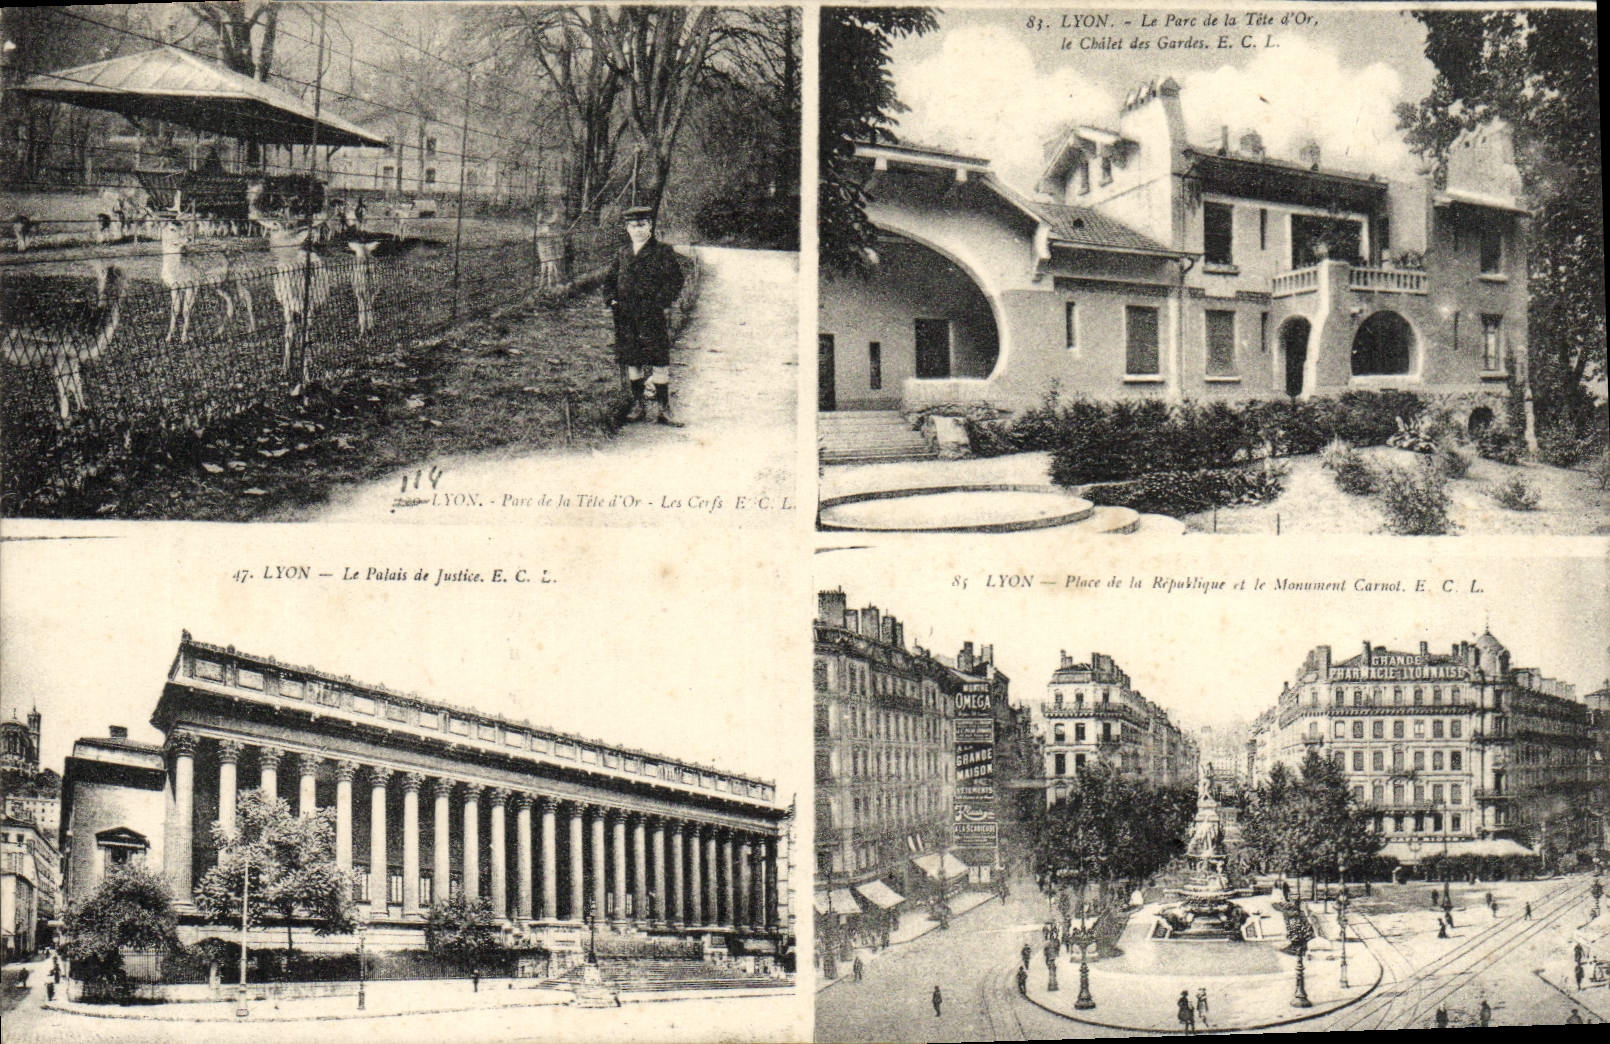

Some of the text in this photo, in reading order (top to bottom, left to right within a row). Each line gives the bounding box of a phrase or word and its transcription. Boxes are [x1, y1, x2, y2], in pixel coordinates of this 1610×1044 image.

[1371, 656, 1421, 666] GRANDE
[1329, 666, 1465, 680] PHARMACIE LYONNAISE
[955, 693, 991, 710] OMEGA
[956, 748, 993, 767] GRANDE
[956, 763, 993, 782] MAISON
